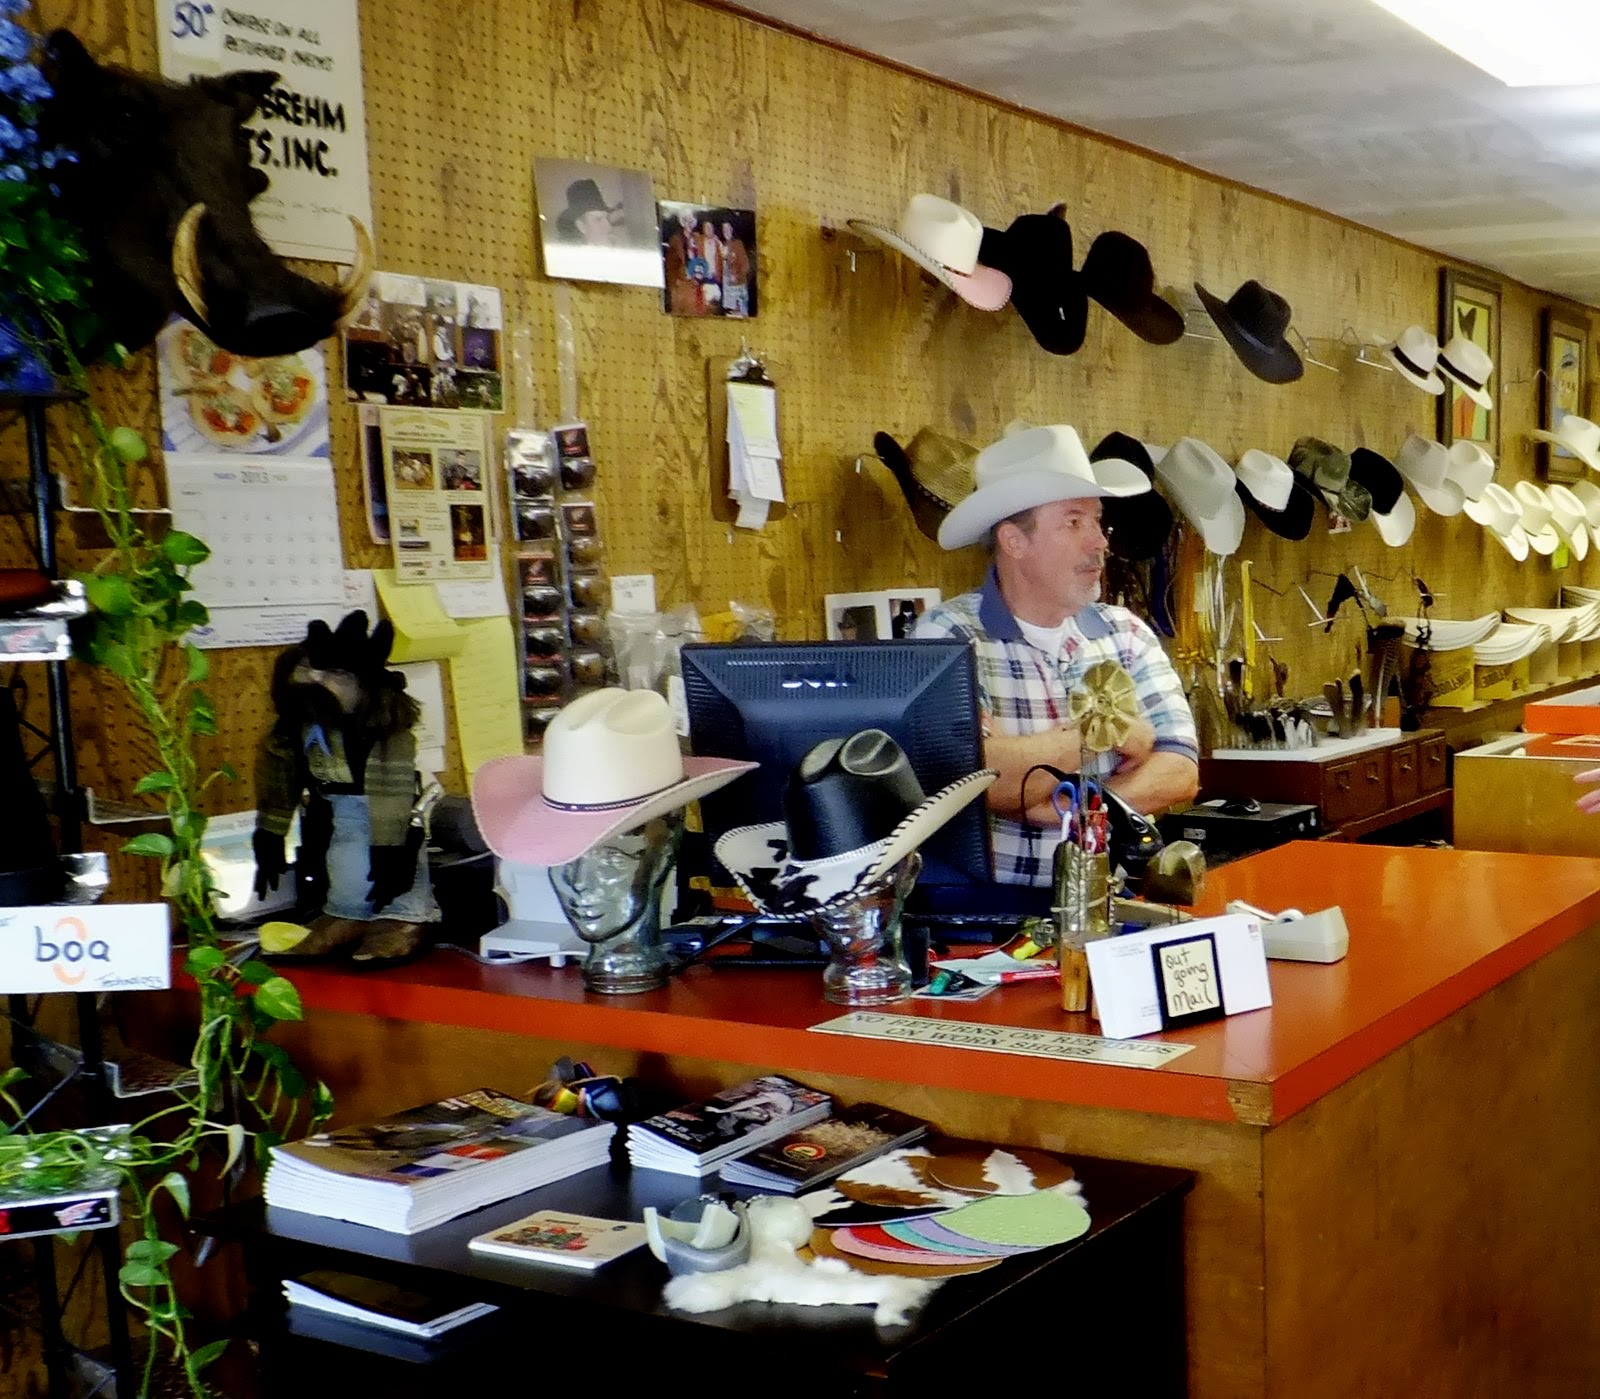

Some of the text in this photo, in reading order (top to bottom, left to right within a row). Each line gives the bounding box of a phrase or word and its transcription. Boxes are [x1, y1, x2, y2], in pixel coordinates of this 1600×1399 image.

[34, 925, 111, 963] boa
[1173, 962, 1209, 988] going
[851, 1013, 1178, 1056] NO RETURNS OR REFUNDS
[884, 1027, 1097, 1058] ON WORN SHOES
